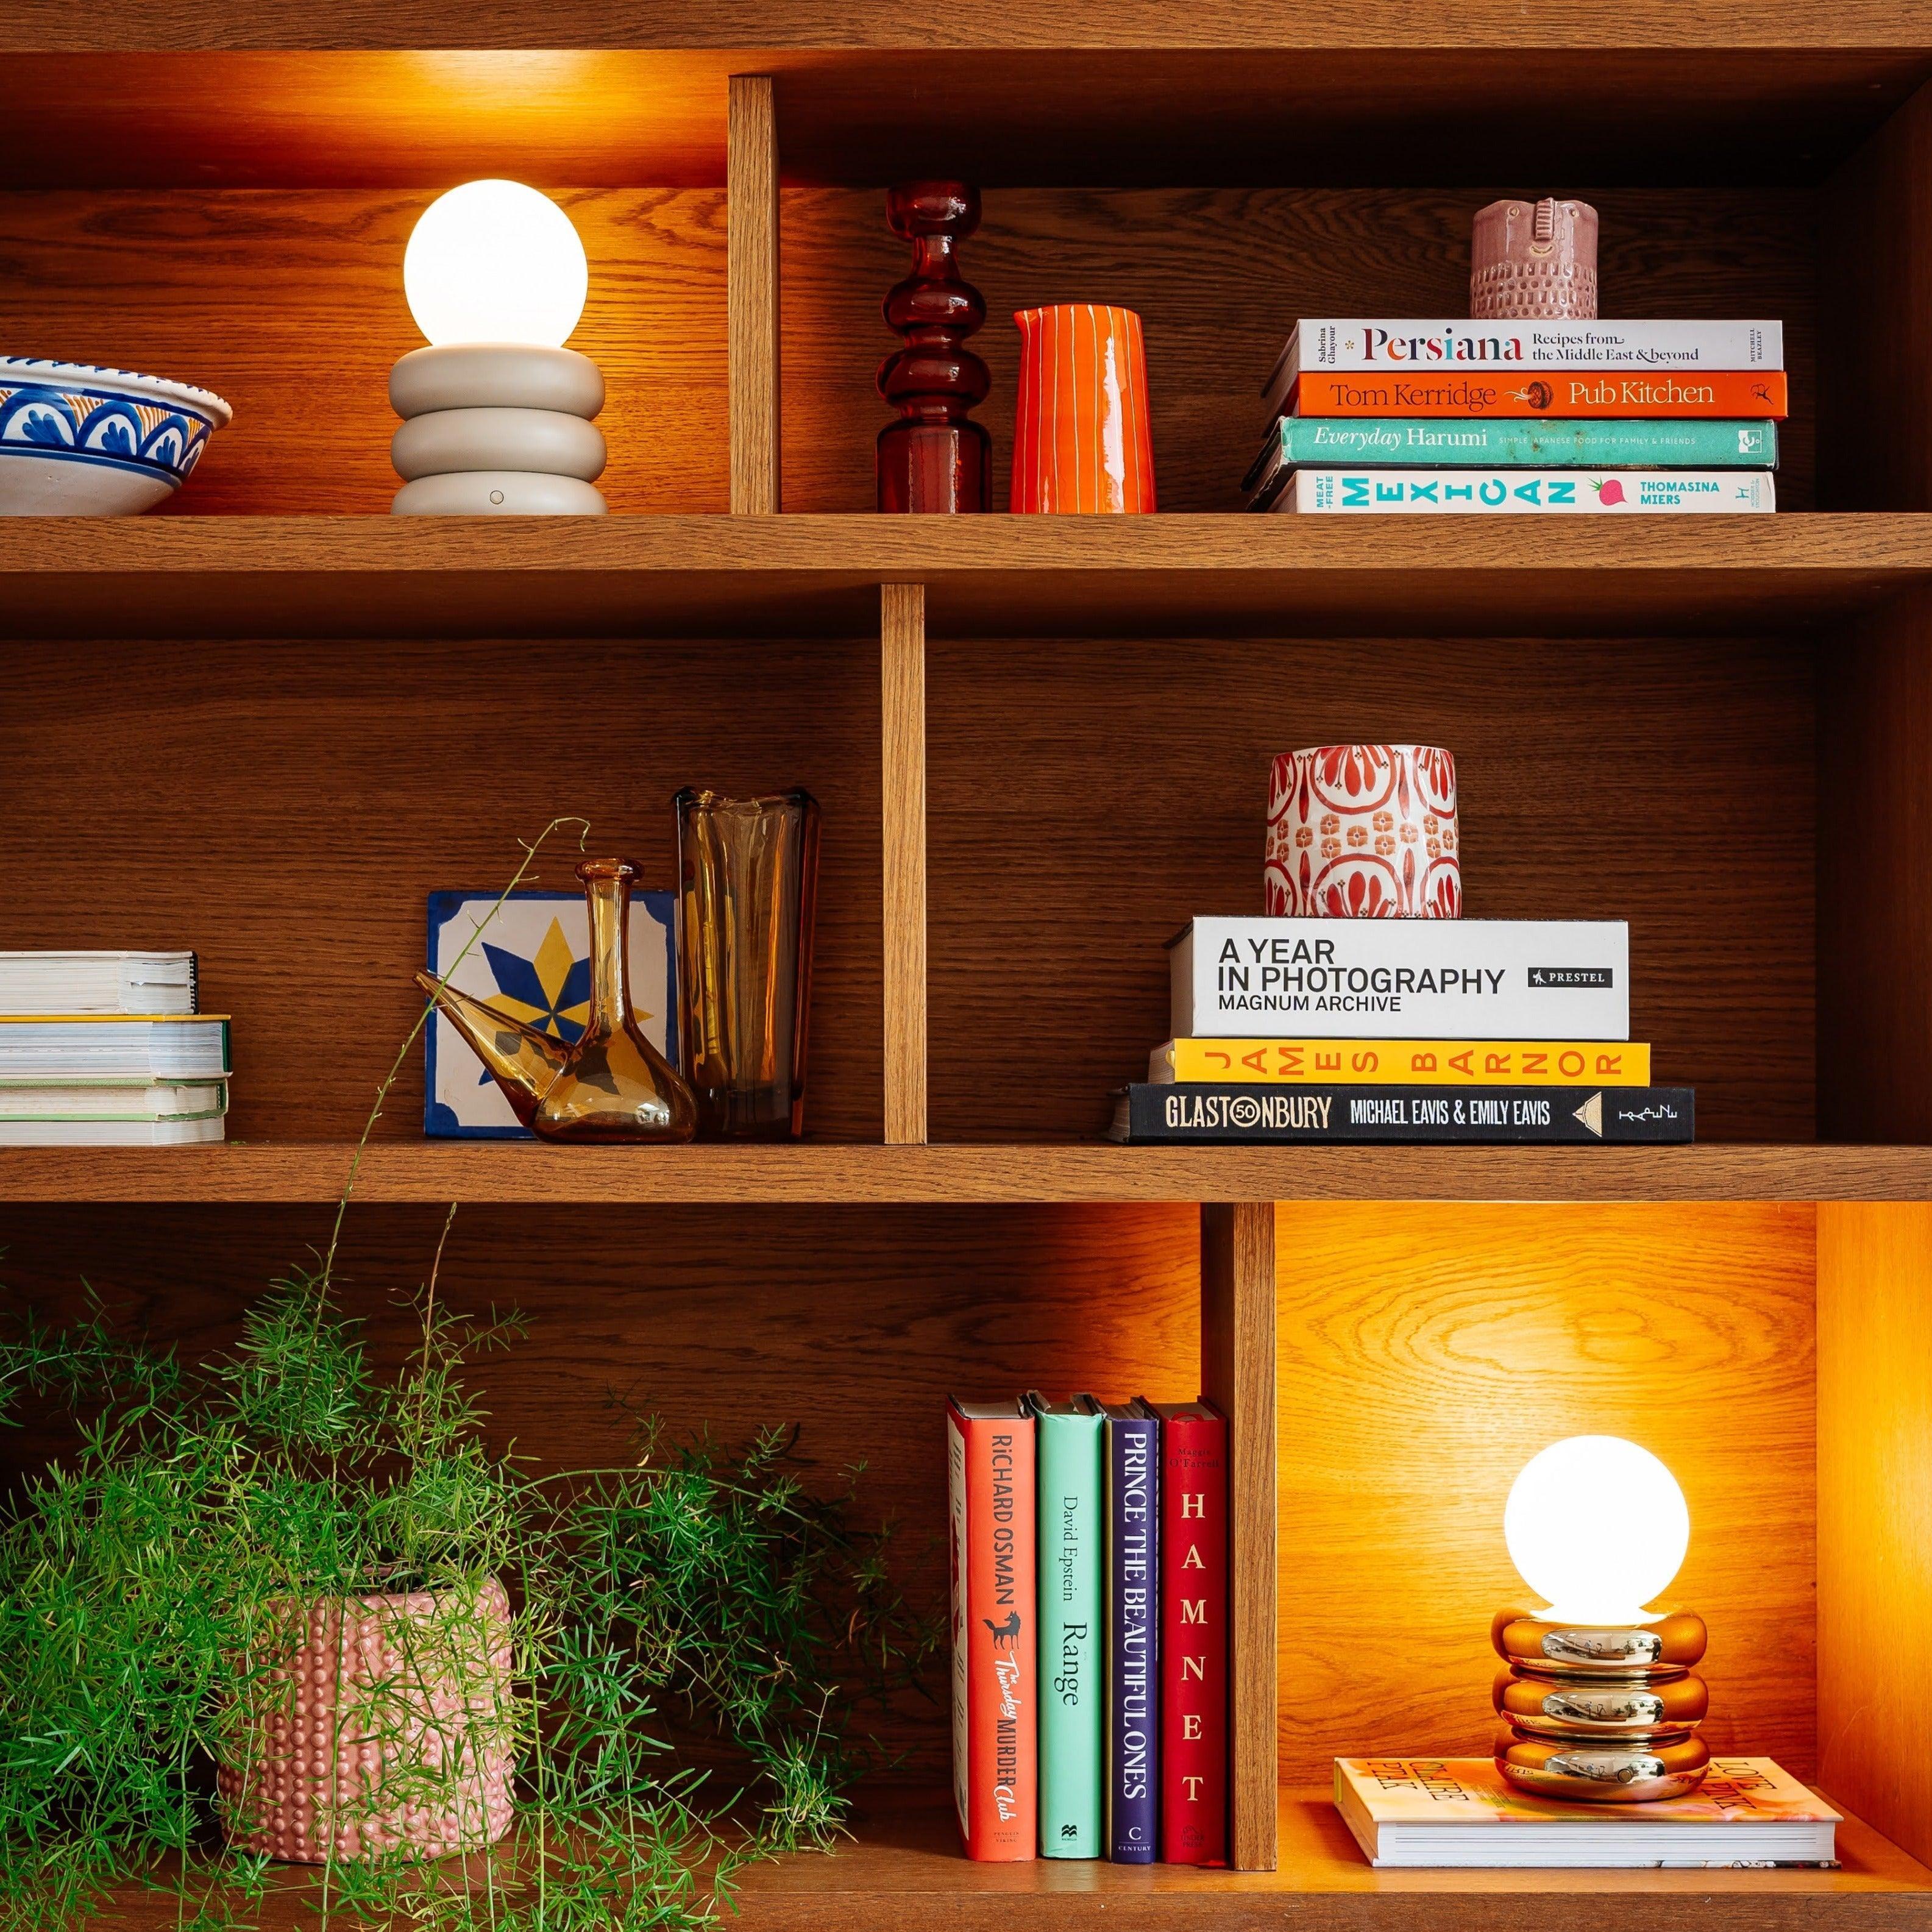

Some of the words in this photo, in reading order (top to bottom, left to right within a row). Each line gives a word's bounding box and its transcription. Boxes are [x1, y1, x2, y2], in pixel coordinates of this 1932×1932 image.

[1361, 327, 1524, 361] Persiana
[1533, 333, 1583, 347] Recipes
[1586, 333, 1625, 344] from
[1532, 349, 1553, 360] the
[1556, 349, 1602, 360] Middle
[1606, 349, 1634, 360] East
[1636, 350, 1653, 363] &
[1650, 349, 1699, 364] beyond
[1330, 384, 1390, 406] Tom
[1393, 381, 1497, 412] Kerridge
[1569, 380, 1616, 405] Pub
[1619, 380, 1716, 405] Kitchen
[1313, 427, 1401, 451] Everyday
[1407, 428, 1488, 446] Harumi
[1341, 478, 1575, 506] MEXICAN
[1640, 481, 1720, 492] THOMASINA
[1640, 495, 1680, 505] MIERS
[1218, 938, 1240, 964] A
[1248, 939, 1335, 964] YEAR
[1218, 966, 1249, 992] IN
[1262, 967, 1505, 994] PHOTOGRAPHY
[1549, 972, 1605, 982] PRESTEL
[1218, 995, 1310, 1011] MAGNUM
[1315, 996, 1401, 1012] ARCHIVE
[1204, 1046, 1379, 1076] JAMES
[1411, 1049, 1622, 1078] BARNOR
[1351, 1099, 1408, 1124] MICHAEL
[1412, 1099, 1449, 1125] EAVIS
[1453, 1100, 1465, 1124] &
[1470, 1099, 1510, 1125] EMILY
[1513, 1100, 1550, 1126] EAVIS
[1618, 1104, 1678, 1121] TRAPEZE
[1124, 1432, 1148, 1523] PRINCE
[1063, 1496, 1078, 1542] David
[993, 1527, 1015, 1605] OSMAN
[1124, 1529, 1147, 1582] THE
[1059, 1546, 1078, 1602] Epstein
[1124, 1588, 1147, 1728] BEAUTIFUL
[1180, 1493, 1208, 1802] HAMNET
[1054, 1622, 1088, 1706] Range
[995, 1651, 1023, 1720] Thursday
[997, 1719, 1017, 1786] MURDER
[1123, 1731, 1147, 1799] ONES
[1367, 1762, 1418, 1790] PTAK
[1408, 1761, 1469, 1801] CLAIRE
[1714, 1762, 1777, 1789] LOVE
[993, 1785, 1017, 1823] Club
[1700, 1781, 1758, 1809] PINK
[1128, 1827, 1142, 1841] C
